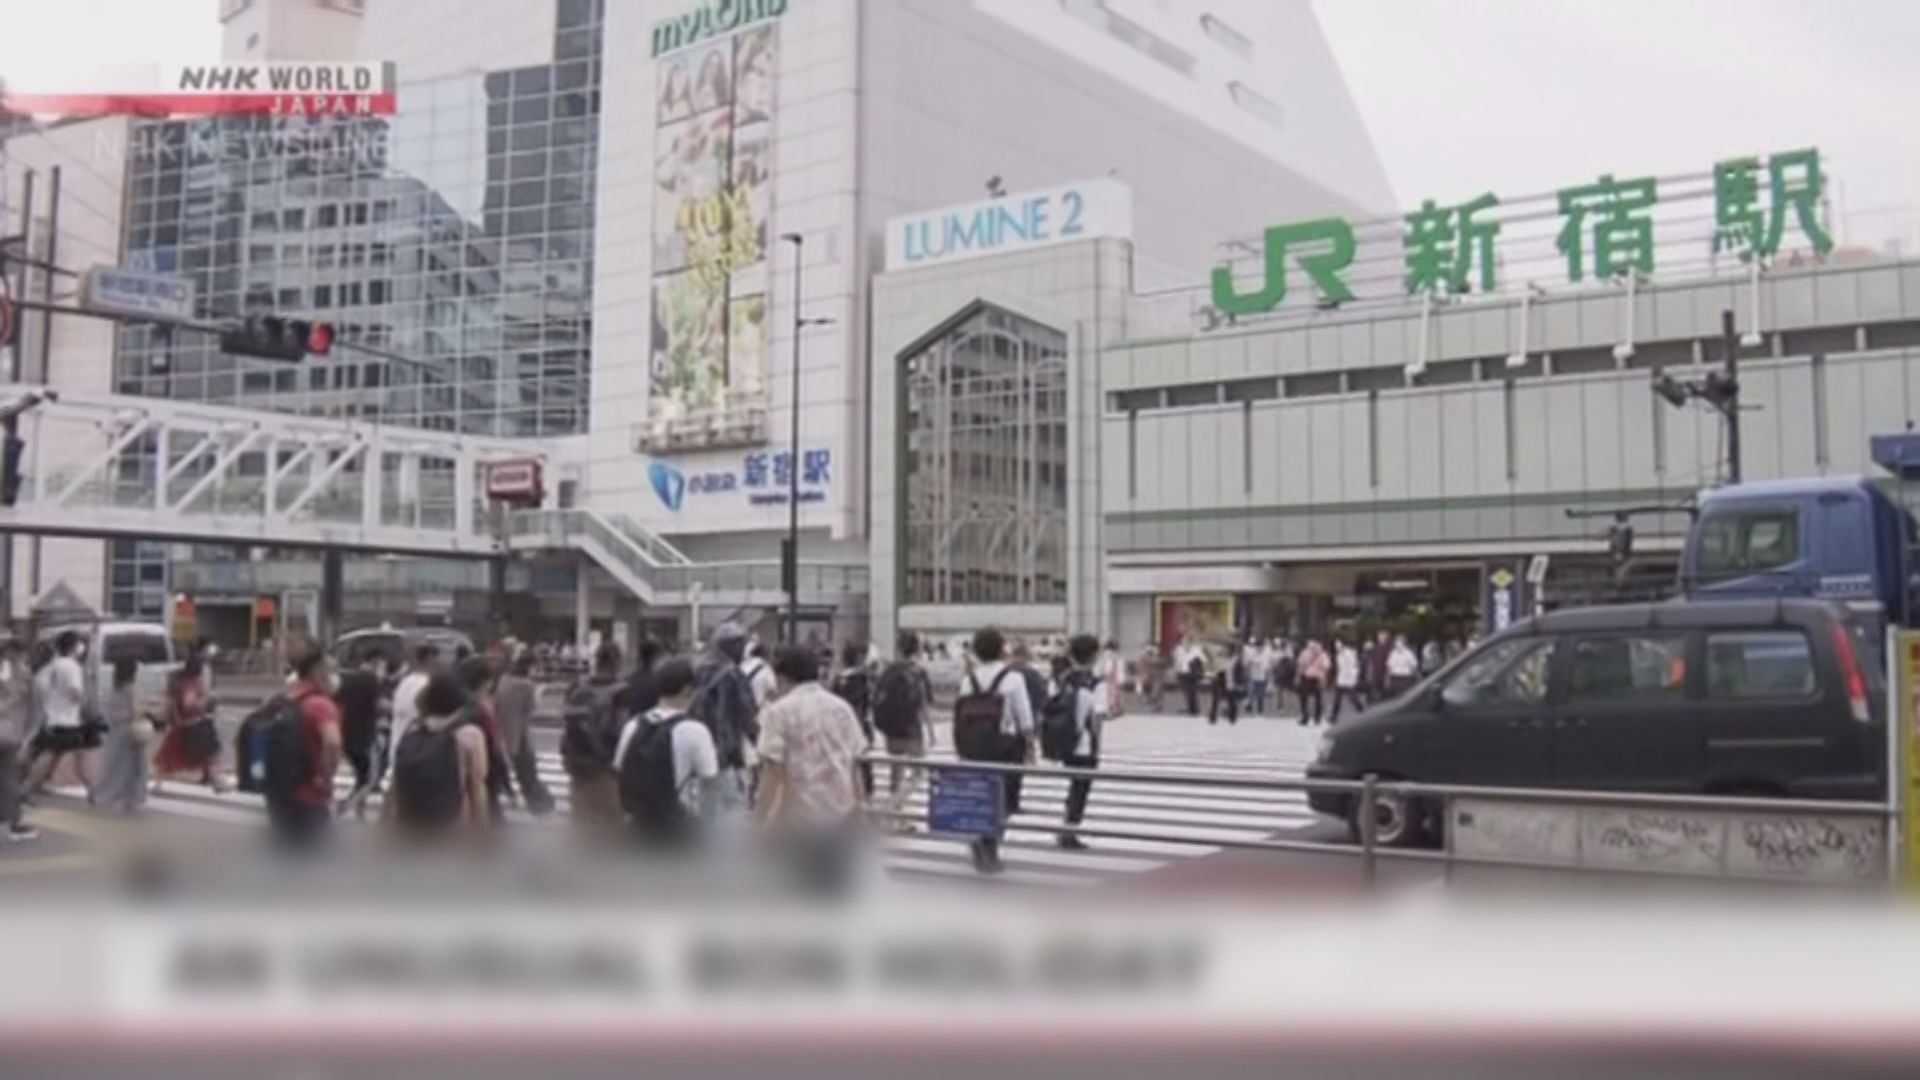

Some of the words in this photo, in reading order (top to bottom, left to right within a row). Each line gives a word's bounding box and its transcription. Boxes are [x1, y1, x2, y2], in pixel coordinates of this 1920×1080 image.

[903, 196, 1049, 261] LUMINE
[1060, 190, 1084, 235] 2
[1210, 217, 1356, 314] JR
[1400, 147, 1834, 297] 新宿駅
